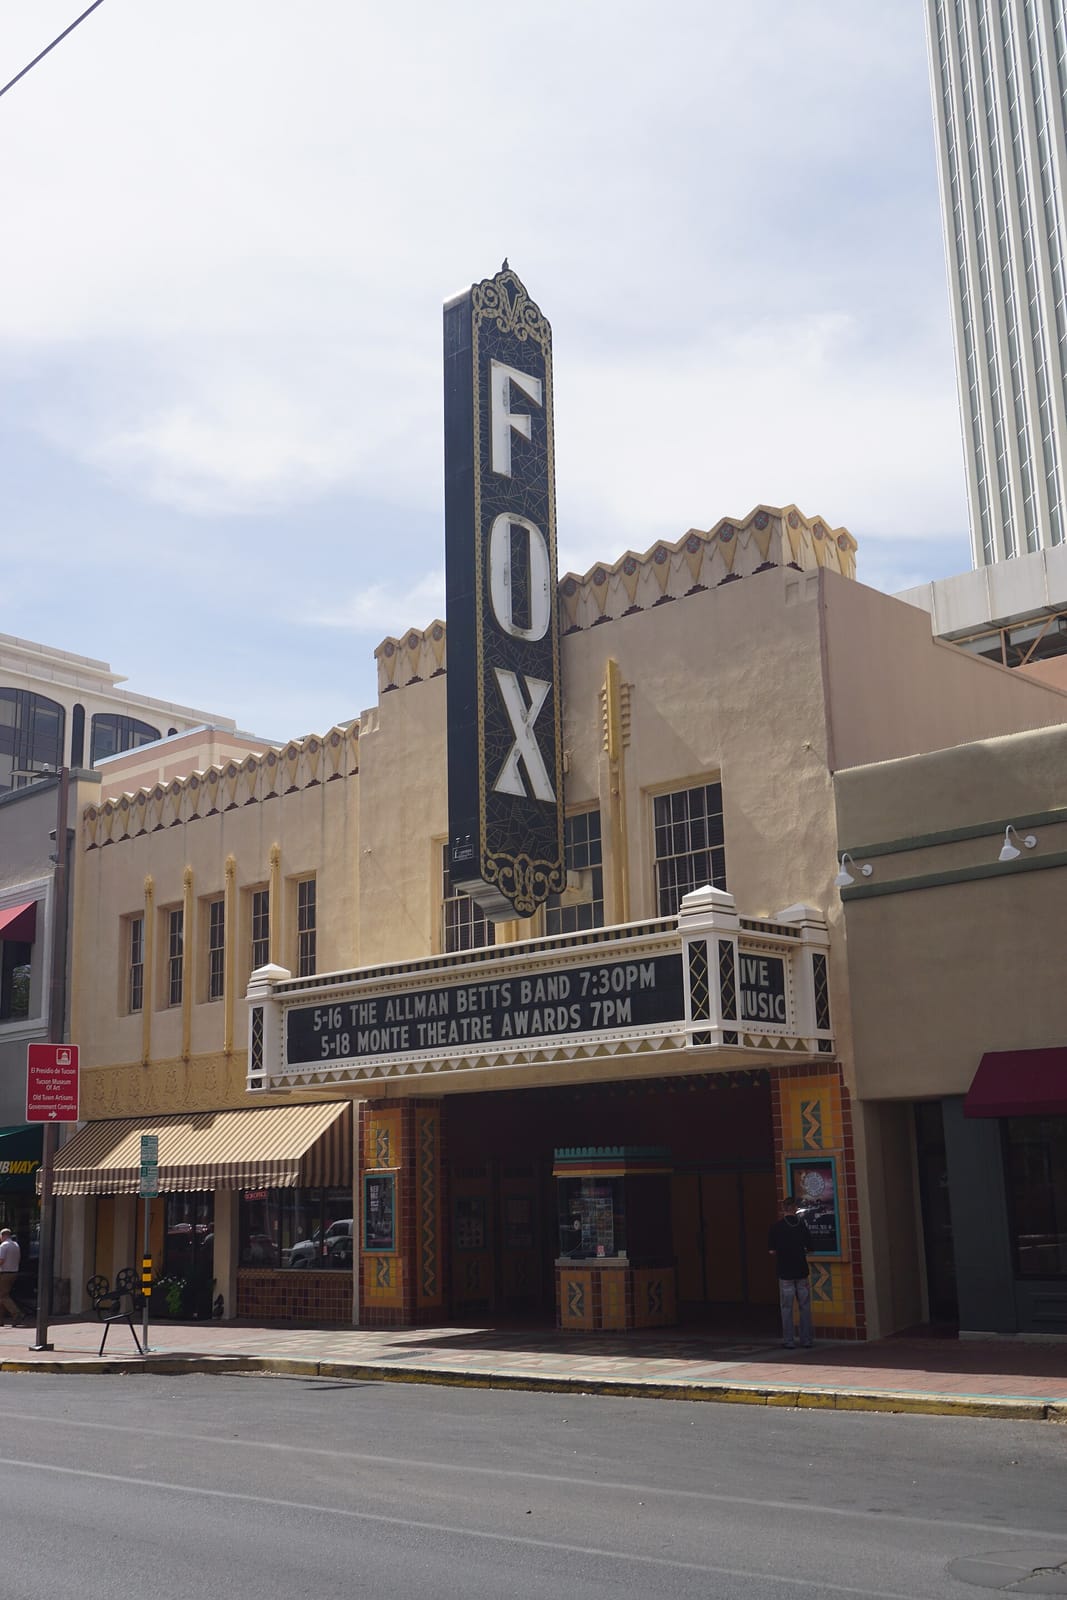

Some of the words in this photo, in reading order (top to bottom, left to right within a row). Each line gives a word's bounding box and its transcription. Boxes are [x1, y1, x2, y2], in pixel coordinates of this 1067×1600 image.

[489, 358, 556, 803] FOX
[313, 1007, 342, 1031] 5-16
[350, 1002, 377, 1026] THE
[384, 991, 449, 1023] ALLMAN
[456, 983, 512, 1013] BETTS
[520, 975, 571, 1005] BAND
[579, 962, 656, 997] 7:30PM
[740, 958, 769, 986] IVE
[321, 1033, 350, 1057] 5-18
[357, 1026, 409, 1053] MONTE
[417, 1015, 492, 1046] THEATRE
[501, 1003, 581, 1037] AWARDS
[590, 997, 632, 1027] 7PM
[0, 1160, 39, 1174] BWAY
